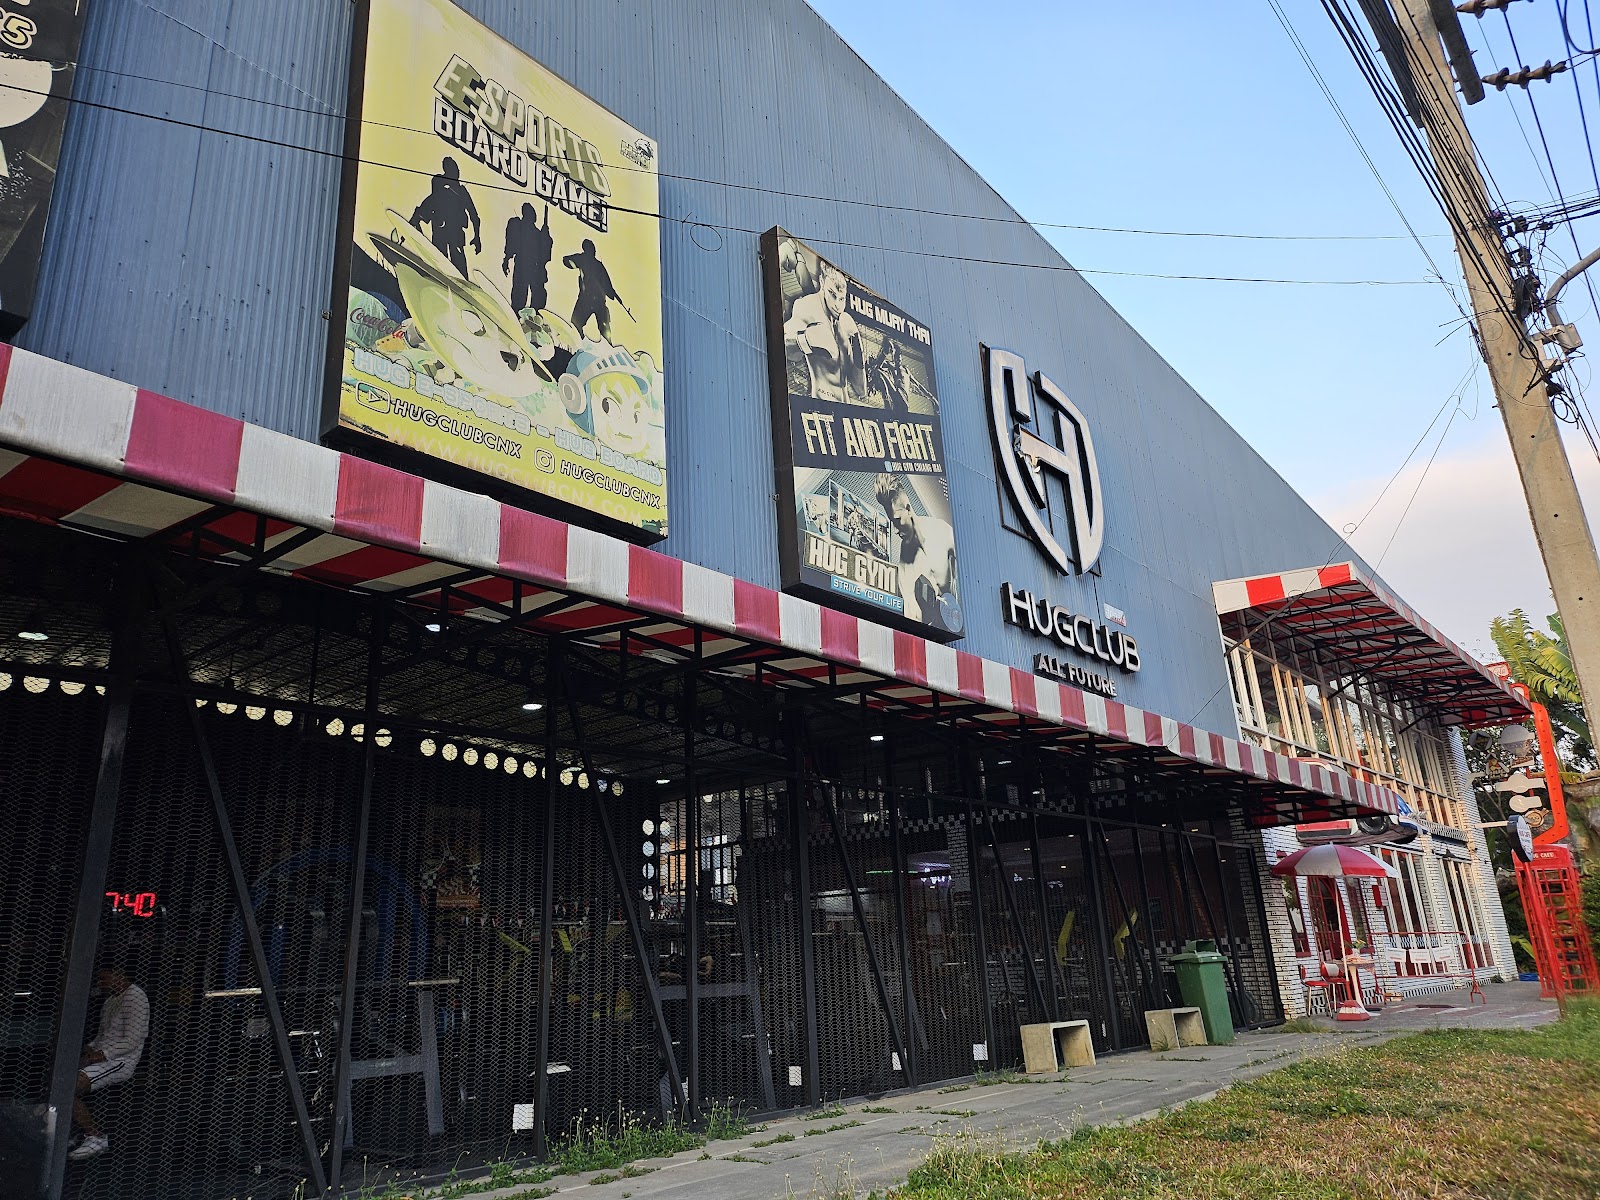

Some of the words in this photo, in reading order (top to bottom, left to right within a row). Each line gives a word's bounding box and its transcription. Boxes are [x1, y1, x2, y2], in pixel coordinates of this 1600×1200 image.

[433, 54, 611, 198] E-SPORTS
[434, 97, 529, 188] BOARD
[535, 161, 608, 233] GAME!
[849, 293, 874, 320] HUG
[875, 304, 907, 333] MUAY
[907, 322, 931, 346] THAI
[354, 348, 410, 389] HUG
[554, 427, 597, 461] HUG
[600, 444, 663, 486] BOARD
[393, 398, 523, 459] HUGCLUBCNX
[801, 411, 838, 456] FIT
[842, 417, 885, 459] AND
[883, 420, 937, 462] FIGHT
[560, 460, 661, 509] HUGCLUBCNX
[809, 536, 848, 577] HUG
[854, 554, 897, 594] GYM
[833, 578, 861, 596] STRIVE
[863, 587, 884, 603] YOUR
[886, 596, 902, 609] LIFE
[1001, 581, 1141, 673] HUGCLUB
[1033, 653, 1066, 680] ALL
[1064, 662, 1118, 698] FUTURE
[105, 891, 156, 917] 7:40
